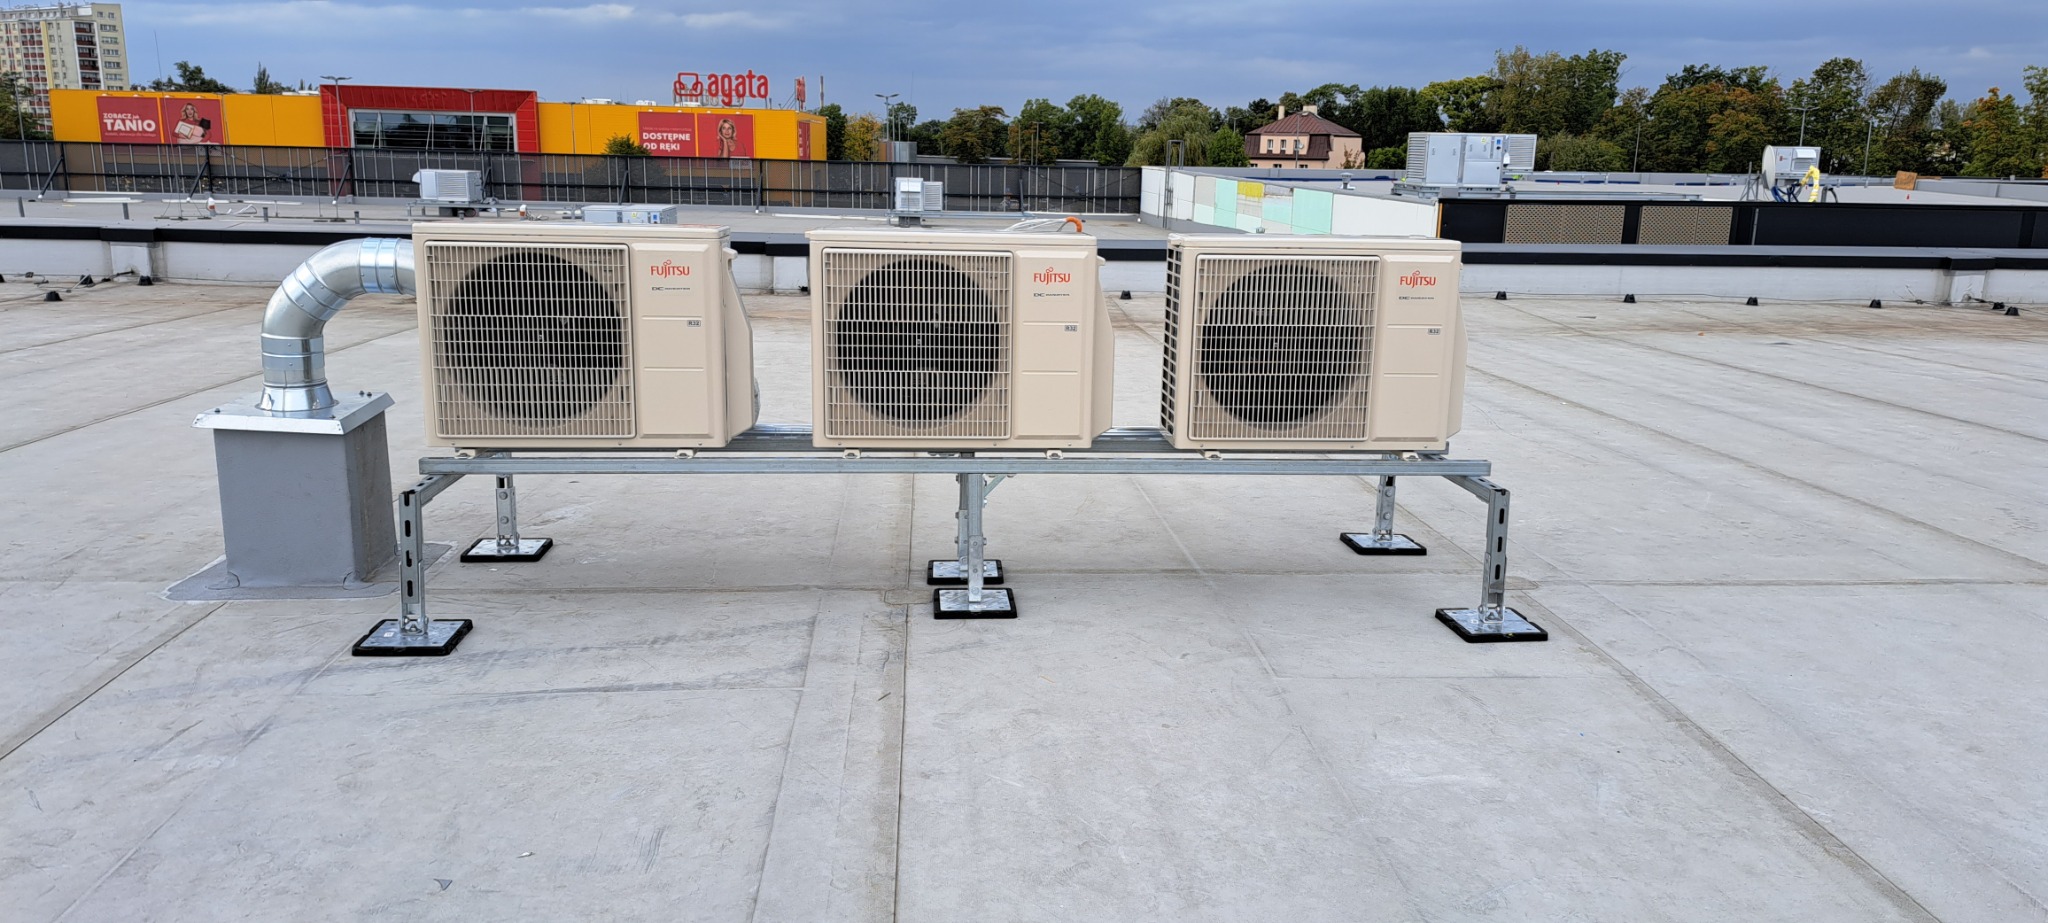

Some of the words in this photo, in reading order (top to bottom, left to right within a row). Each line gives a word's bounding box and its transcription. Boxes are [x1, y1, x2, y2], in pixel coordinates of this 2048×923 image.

[708, 69, 768, 107] agata
[103, 119, 156, 132] TANIO
[642, 132, 691, 142] DOSTĘPNE
[643, 142, 658, 150] OD
[659, 143, 680, 152] RĘKI
[650, 260, 690, 278] FUJITSU
[1033, 267, 1071, 285] FUJITSU
[1400, 271, 1436, 288] FUJITSU
